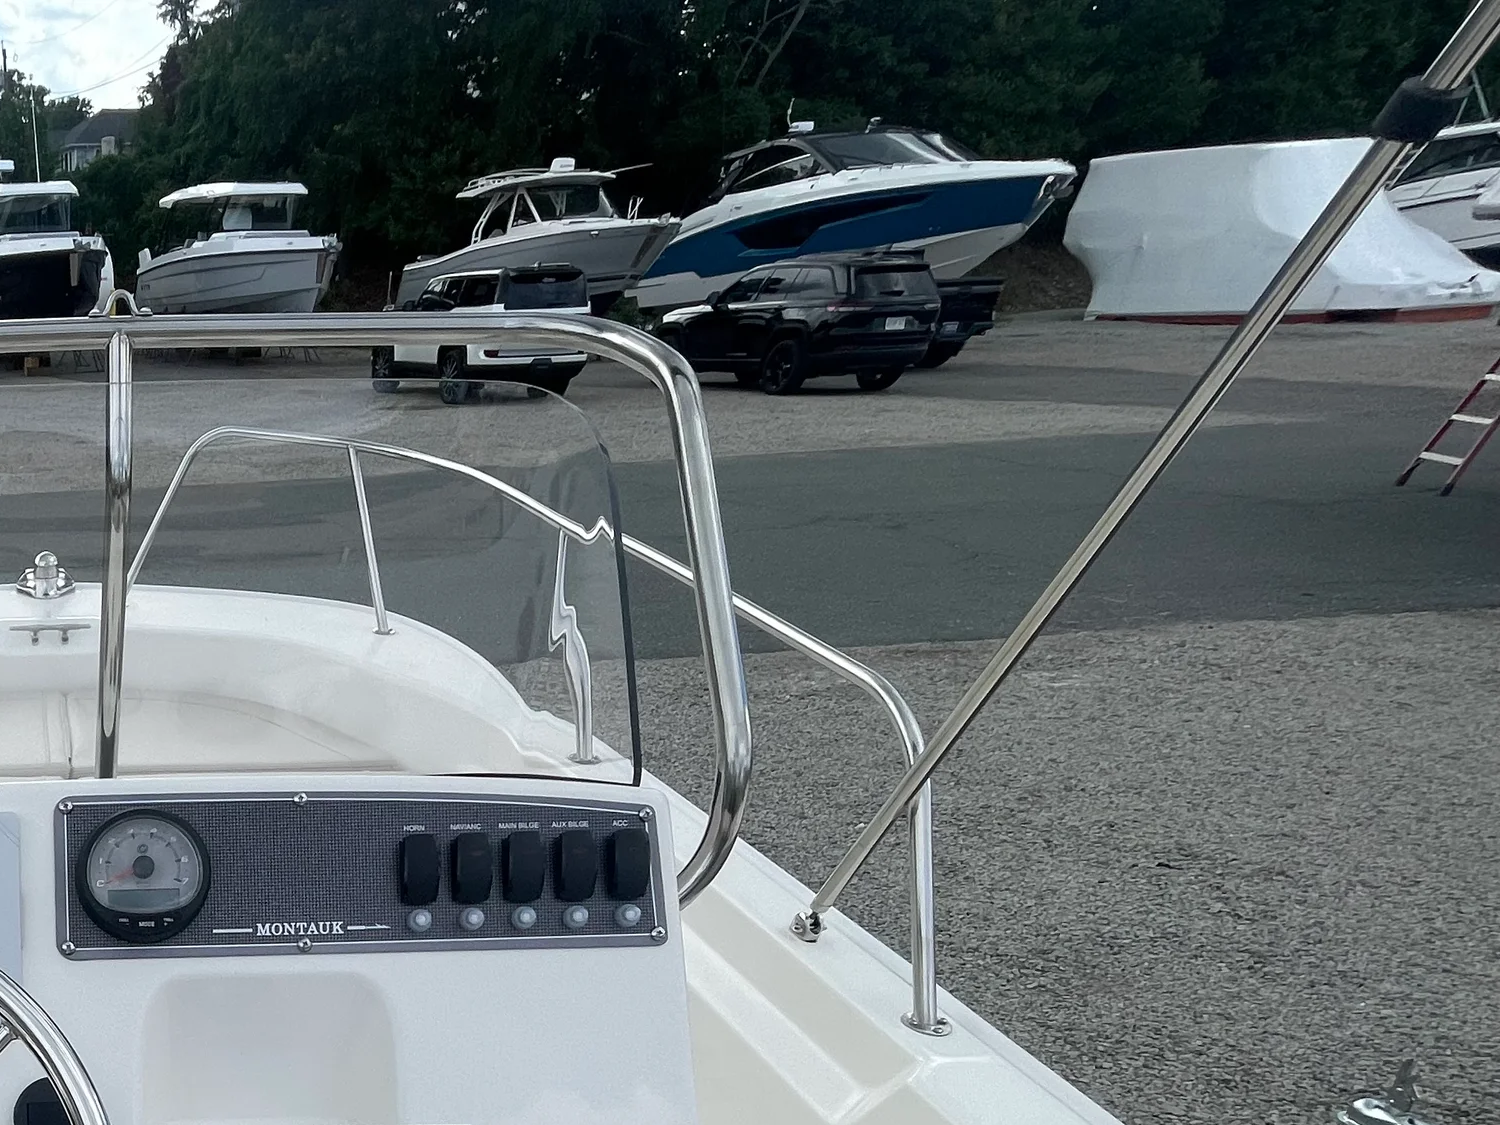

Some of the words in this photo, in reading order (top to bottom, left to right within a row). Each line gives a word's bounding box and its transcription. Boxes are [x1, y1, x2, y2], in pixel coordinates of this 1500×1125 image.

[518, 821, 540, 829] BILGE
[568, 820, 589, 828] BILGE
[612, 819, 629, 827] ACC
[403, 824, 425, 832] HORN
[255, 921, 345, 938] MONTAUK
